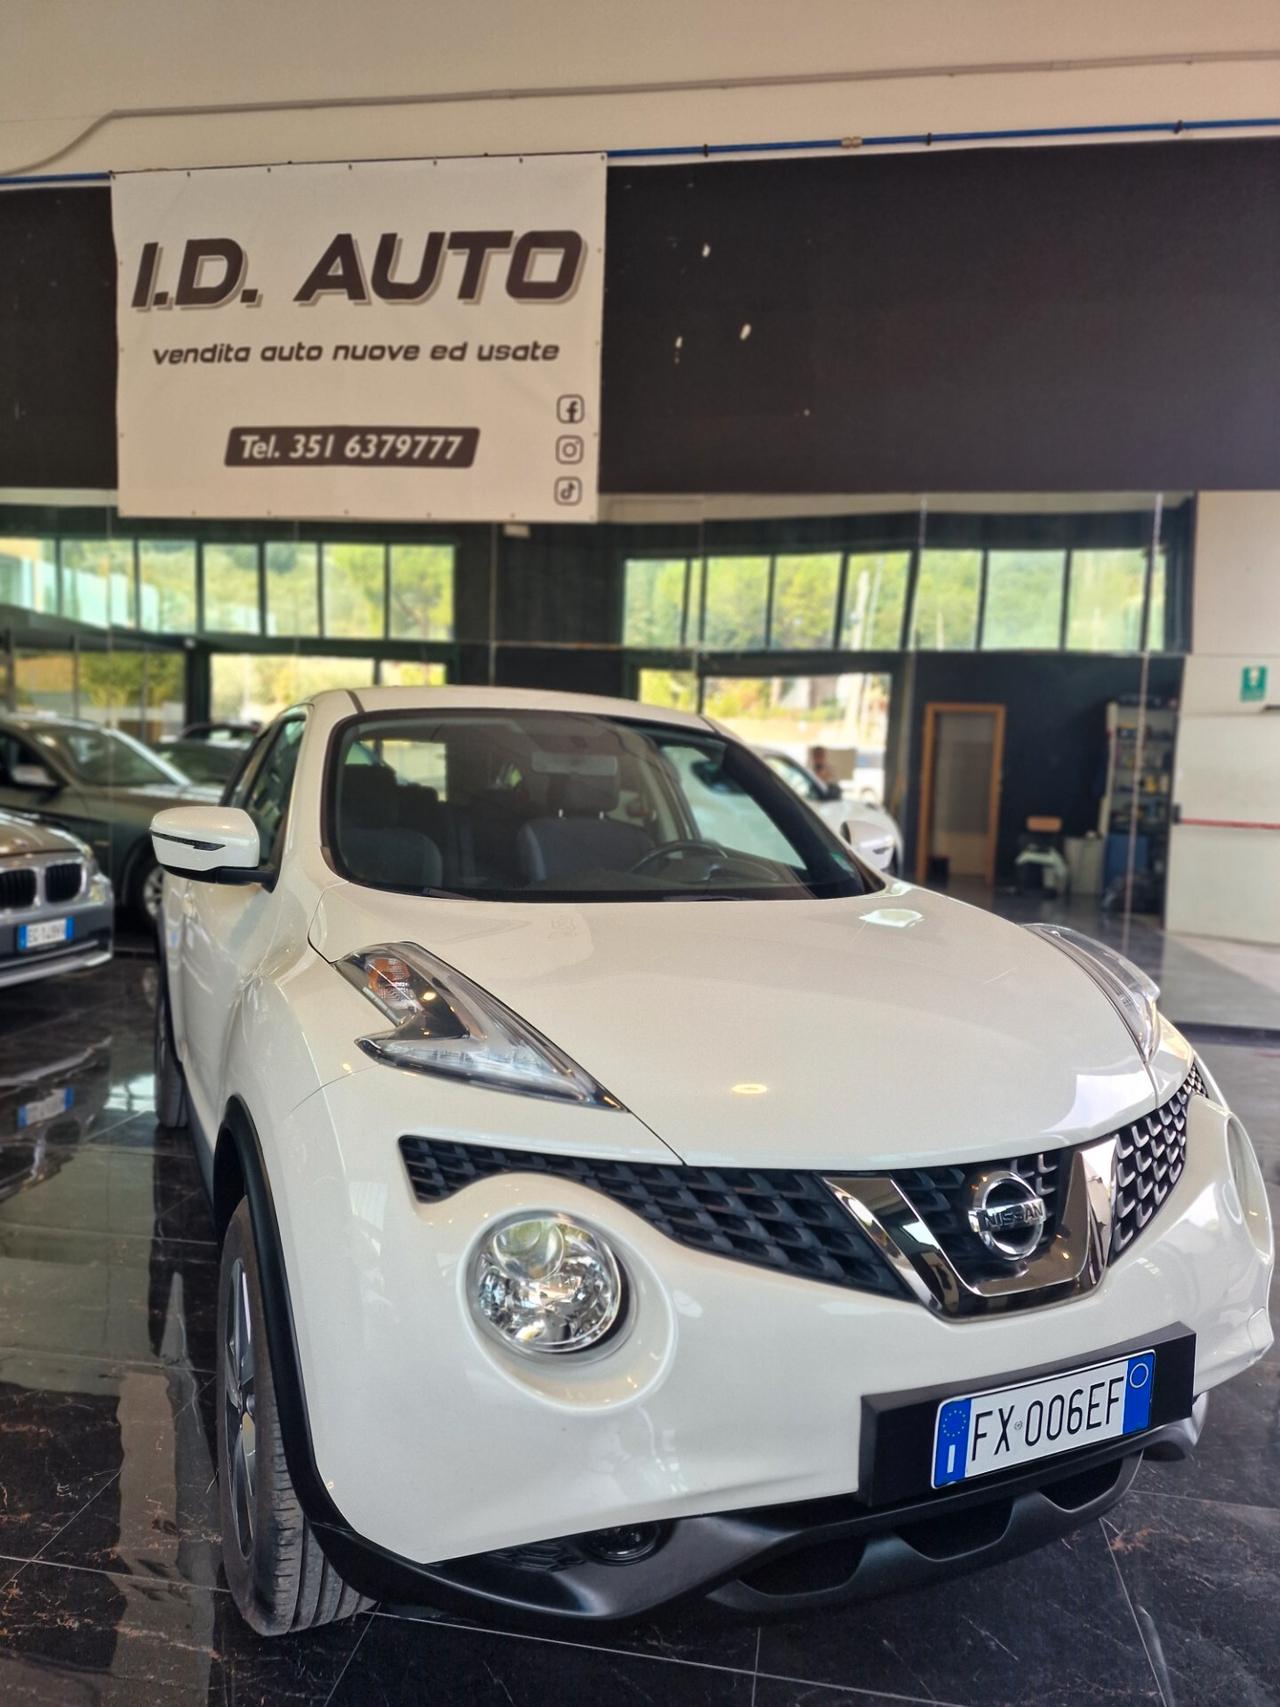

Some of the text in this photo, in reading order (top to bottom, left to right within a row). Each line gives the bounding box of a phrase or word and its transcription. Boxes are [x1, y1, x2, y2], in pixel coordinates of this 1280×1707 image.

[131, 230, 587, 310] I.D. AUTO
[153, 342, 560, 365] vendita auto nuove ed usate
[240, 435, 463, 460] Tel. 351 6379777
